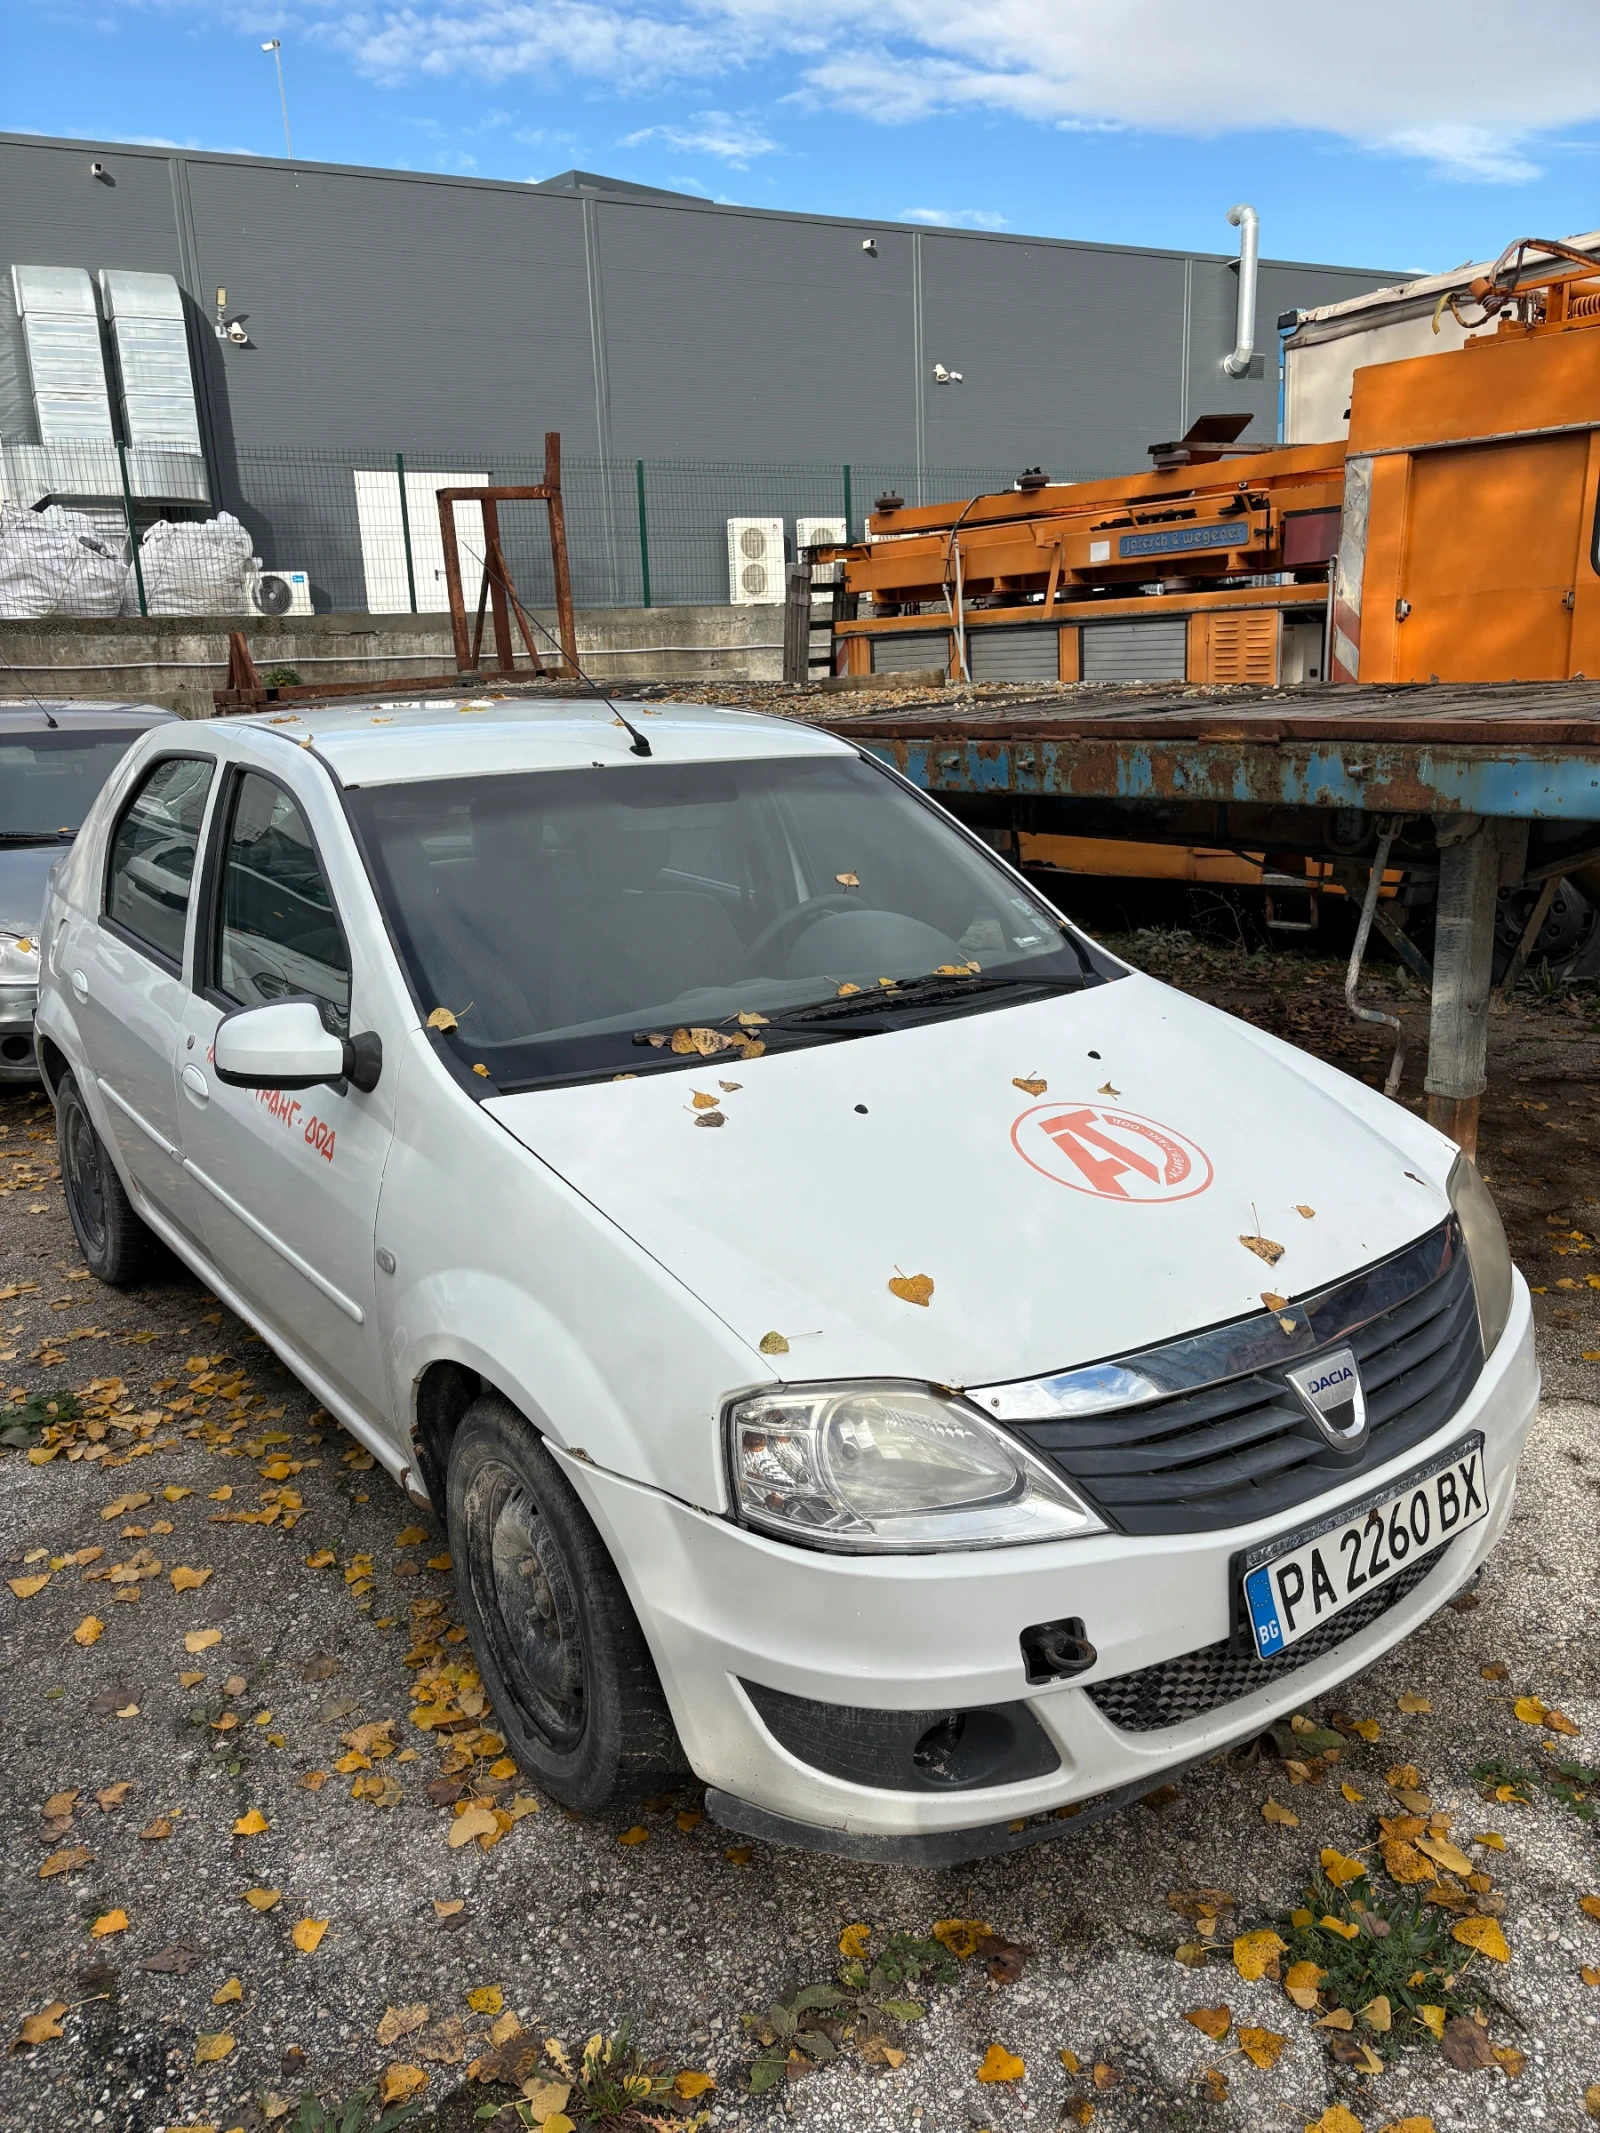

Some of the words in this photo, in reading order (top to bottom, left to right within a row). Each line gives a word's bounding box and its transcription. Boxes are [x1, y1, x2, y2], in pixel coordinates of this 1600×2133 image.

[1125, 533, 1168, 554] jaresch
[1172, 532, 1179, 545] &
[1183, 527, 1242, 546] wegener
[1307, 1367, 1354, 1395] DACIA
[1276, 1547, 1338, 1632] PA
[1340, 1490, 1430, 1594] 2260
[1437, 1454, 1482, 1532] BX
[1258, 1619, 1279, 1645] BG
